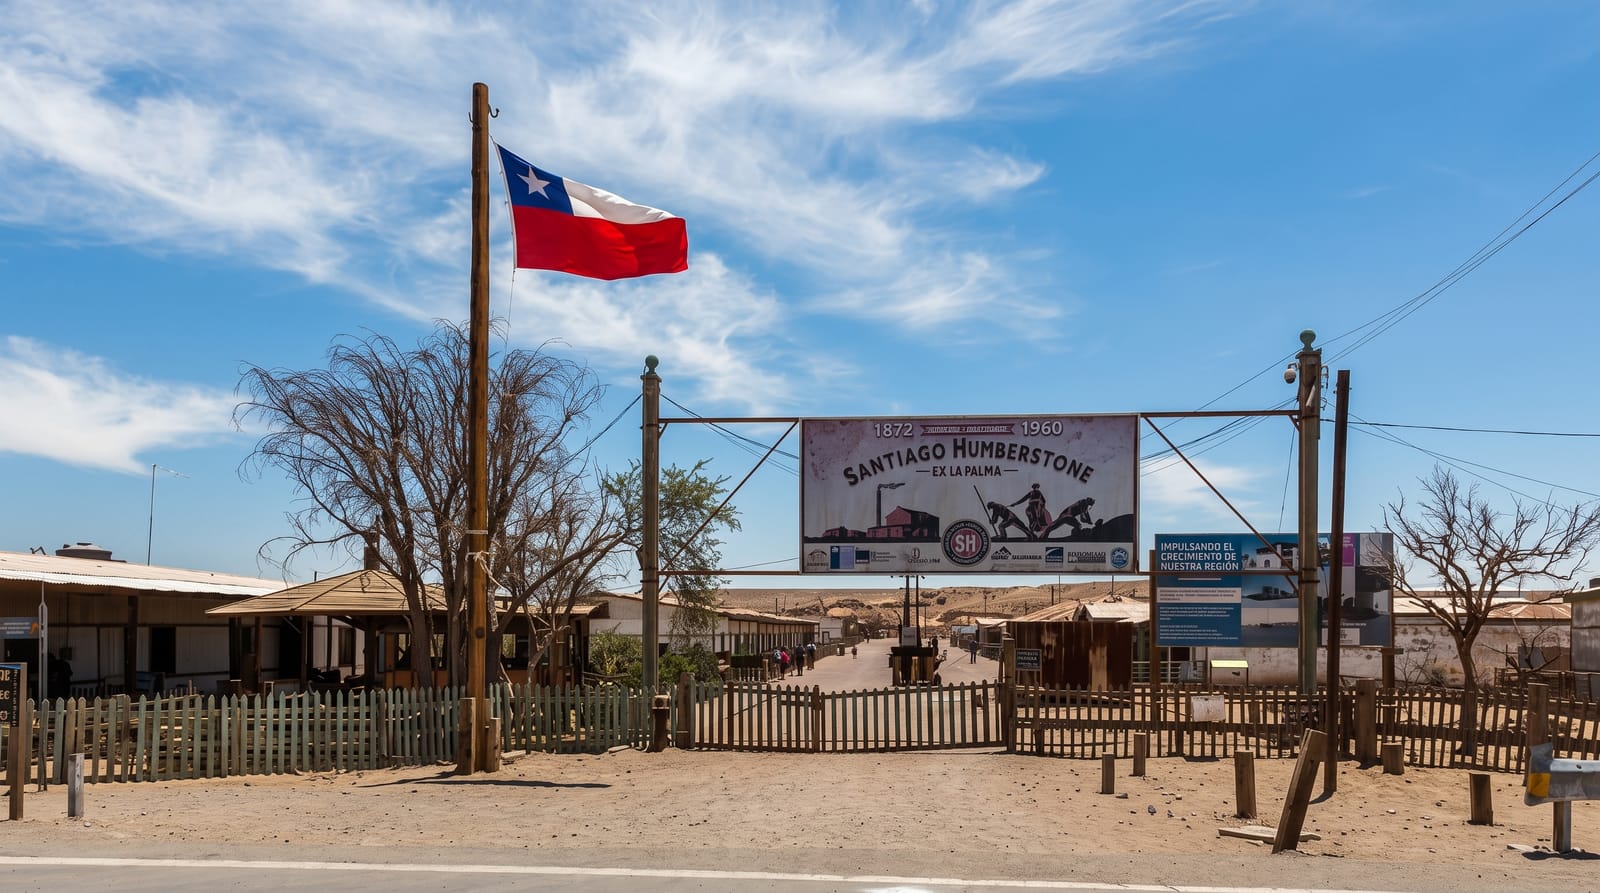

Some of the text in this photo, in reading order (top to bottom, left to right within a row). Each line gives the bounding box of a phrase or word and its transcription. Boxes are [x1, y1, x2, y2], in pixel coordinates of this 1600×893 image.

[874, 423, 913, 438] 1872
[1021, 420, 1063, 436] 1960
[843, 437, 1094, 486] SANTIAGO HUMBERSTONE
[932, 465, 1001, 477] EX LA PALMA
[955, 534, 976, 553] SH
[1160, 542, 1235, 551] IMPULSANDO EL
[1160, 552, 1237, 561] CRECIMIENTO DE
[1160, 561, 1239, 571] NUESTRA REGIÓN
